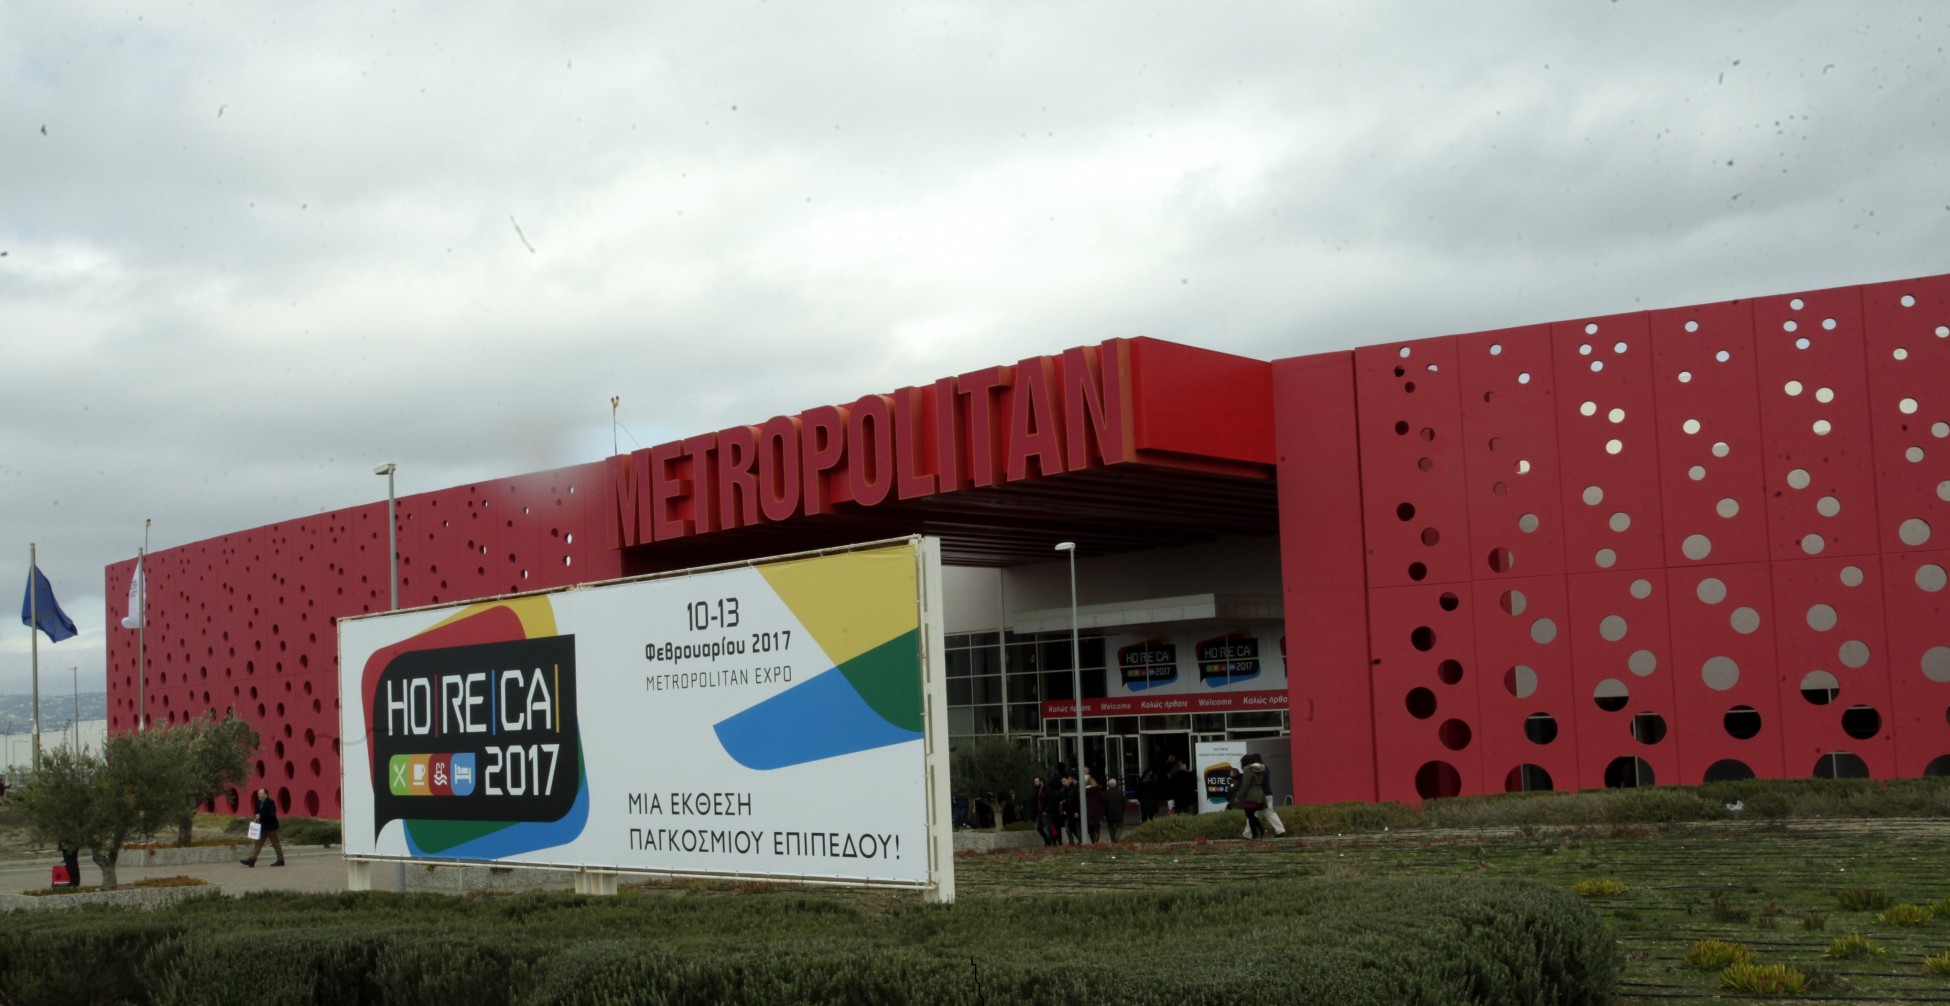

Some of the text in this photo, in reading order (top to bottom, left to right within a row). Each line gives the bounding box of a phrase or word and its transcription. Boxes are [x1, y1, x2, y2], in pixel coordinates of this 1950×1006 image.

[604, 337, 1126, 550] METROPOLITAN
[687, 597, 739, 631] 10-13
[645, 630, 791, 664] Φεβρουαρίου 2017
[1155, 667, 1171, 676] 2017
[1236, 661, 1253, 671] 2017
[646, 665, 792, 691] METROPOLITAN EXPO
[1069, 704, 1091, 714] ήρατε
[1100, 702, 1131, 711] Welcome
[1198, 697, 1233, 706] Welcome
[1269, 695, 1288, 704] ήρθα
[485, 743, 560, 796] 2017
[628, 793, 752, 816] ΜΙΑ ΕΚΘΕΣΗ
[629, 828, 900, 860] ΠΑΓΚΟΣΜΙΟΥ ΕΠΙΠΕΔΟΥ!
